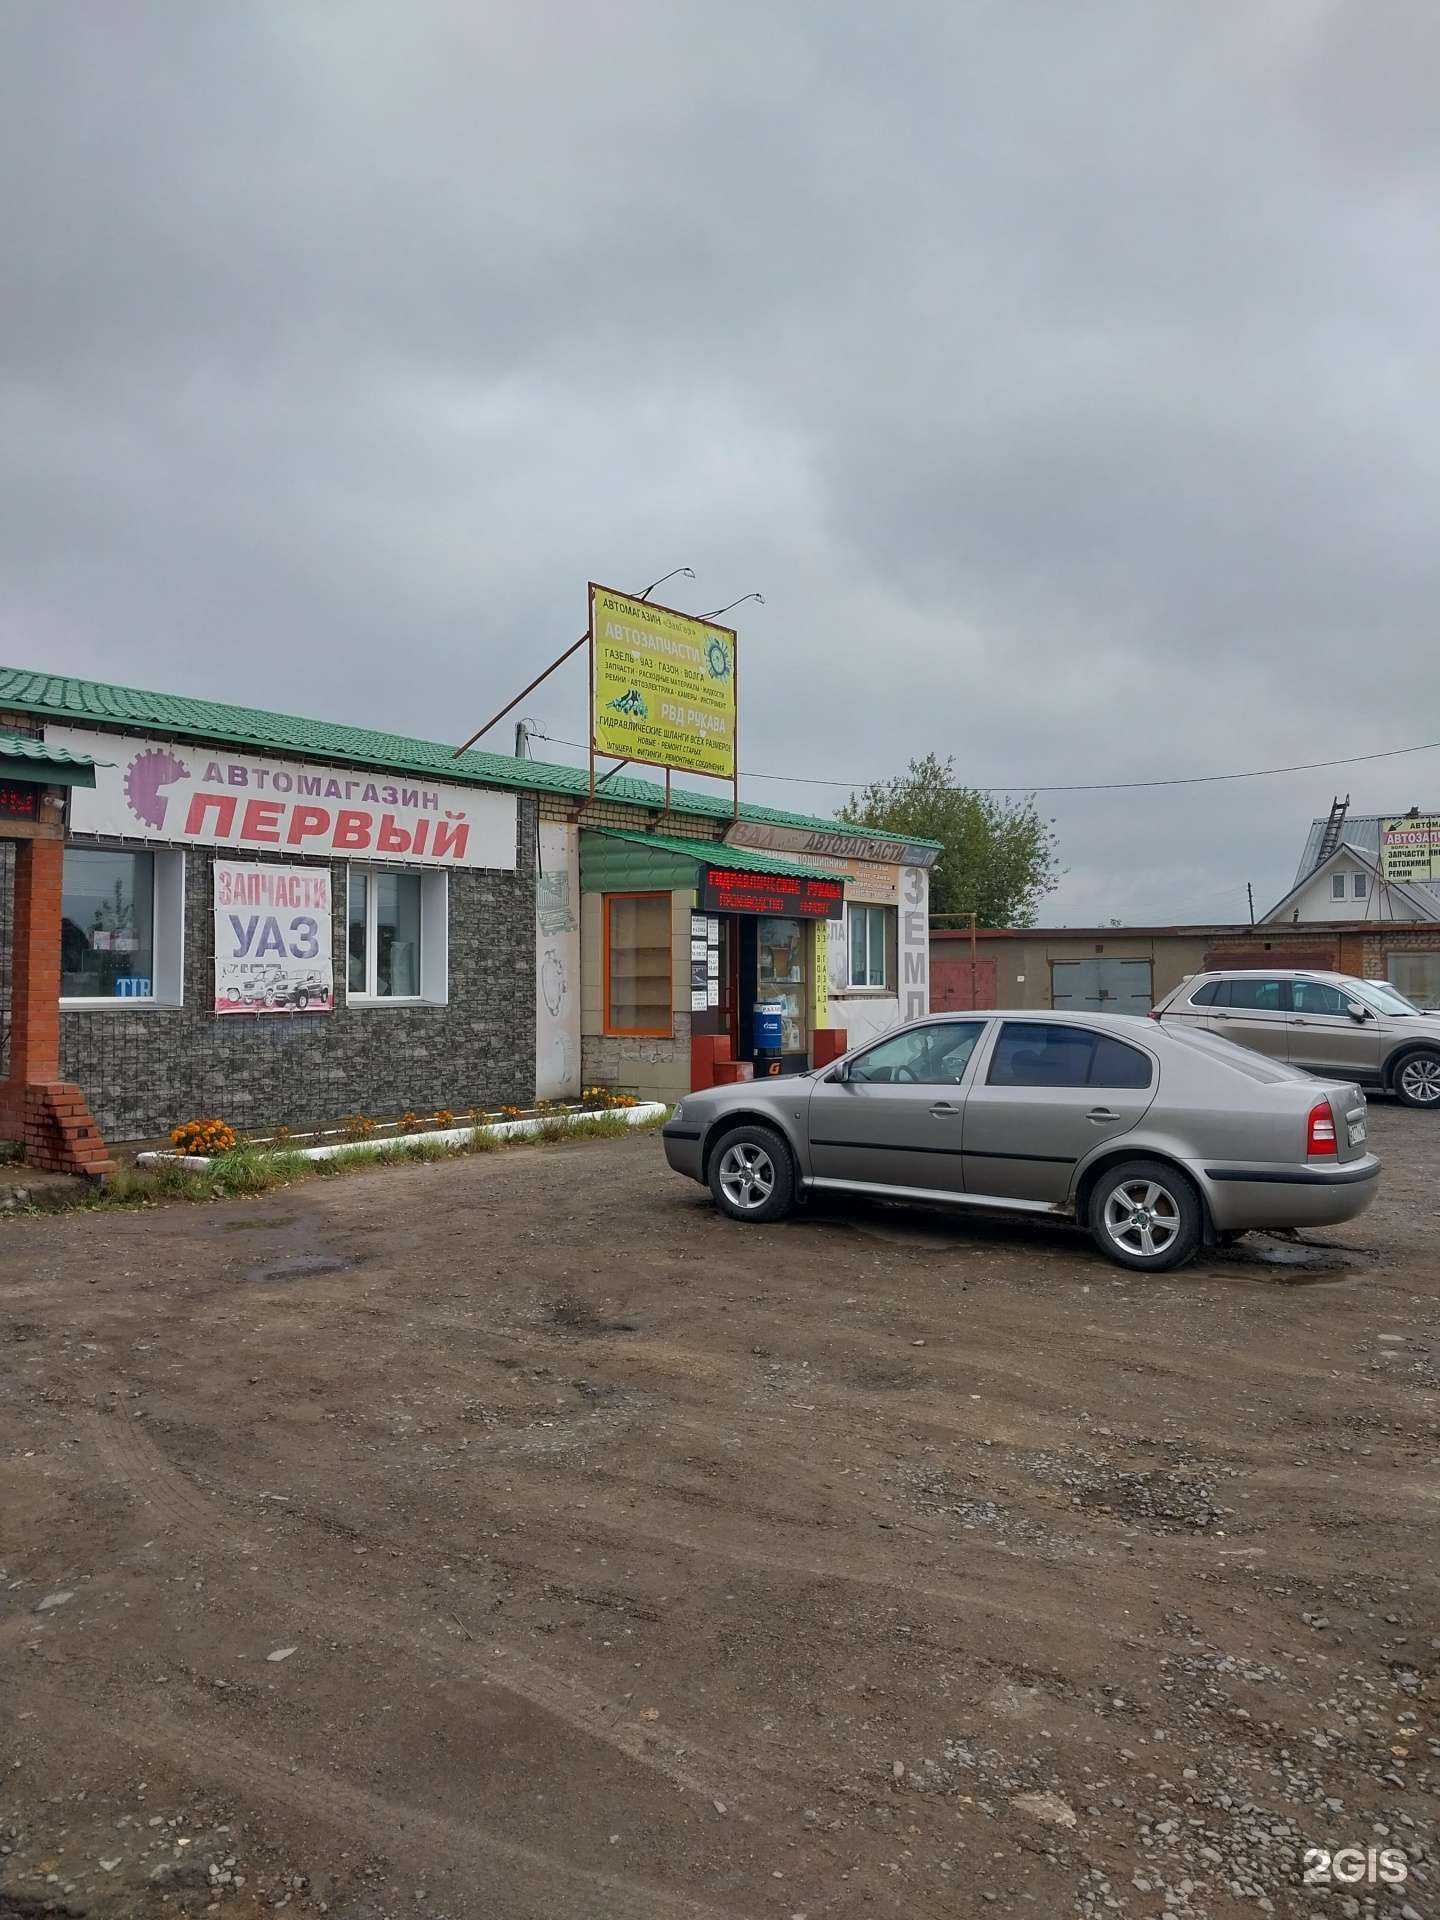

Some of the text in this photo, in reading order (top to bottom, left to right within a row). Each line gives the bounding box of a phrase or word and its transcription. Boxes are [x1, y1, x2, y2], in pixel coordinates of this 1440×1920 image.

[603, 598, 661, 626] АВТОМАГАЗИН
[605, 622, 700, 661] АВТОЗАПЧАСТИ
[604, 648, 705, 682] ГАЗЕЛЬ УАЗ ГАЗОН ВОЛГА
[605, 662, 635, 674] ЗАПЧАСТИ
[605, 672, 626, 683] РЕМНИ
[631, 679, 674, 695] АВТОЭЛЕКТРИКА
[599, 715, 662, 737] ГИДРАВЛИЧЕСКИЕ
[663, 728, 690, 742] ШЛАНГИ
[690, 735, 704, 745] ВСЕХ
[662, 703, 726, 732] РВД РУКАВА
[606, 741, 633, 754] ШТУЦЕРА
[637, 736, 702, 756] НОВЫЕ РЕМОНТ СТАРЫХ
[202, 761, 440, 811] АВТОМАГАЗИН
[183, 791, 470, 859] ПЕРВЫЙ
[803, 832, 907, 862] АВТОЗАПЧАСТИ
[1388, 850, 1425, 858] ЗАПЧАСТИ
[1388, 859, 1431, 867] АВТОХИМИЯ
[1388, 869, 1413, 878] РЕМНИ
[219, 870, 327, 909] ЗАПЧАСТИ
[228, 914, 319, 960] УАЗ
[117, 978, 151, 997] TIR
